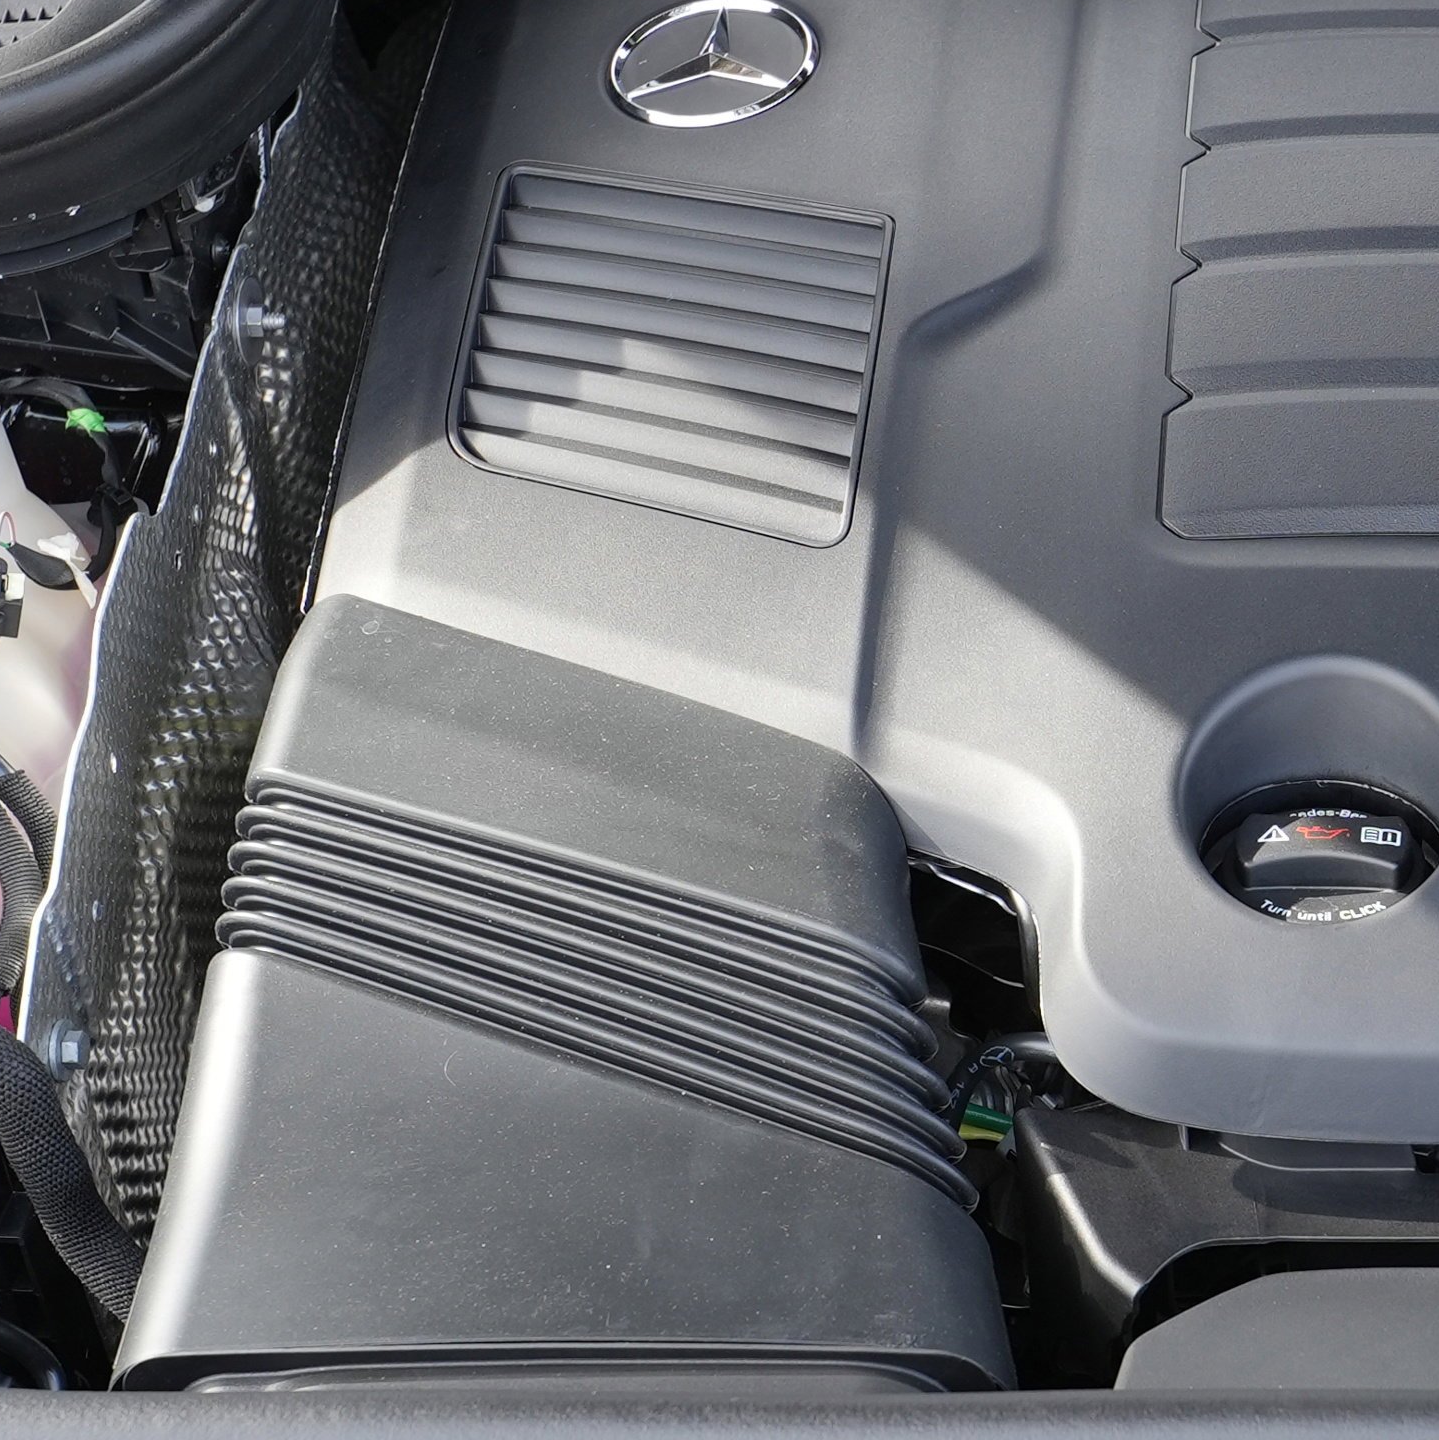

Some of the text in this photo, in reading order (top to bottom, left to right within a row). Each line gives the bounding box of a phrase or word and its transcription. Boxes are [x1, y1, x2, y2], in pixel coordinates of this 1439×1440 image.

[1261, 899, 1387, 921] Turn until CLICK
